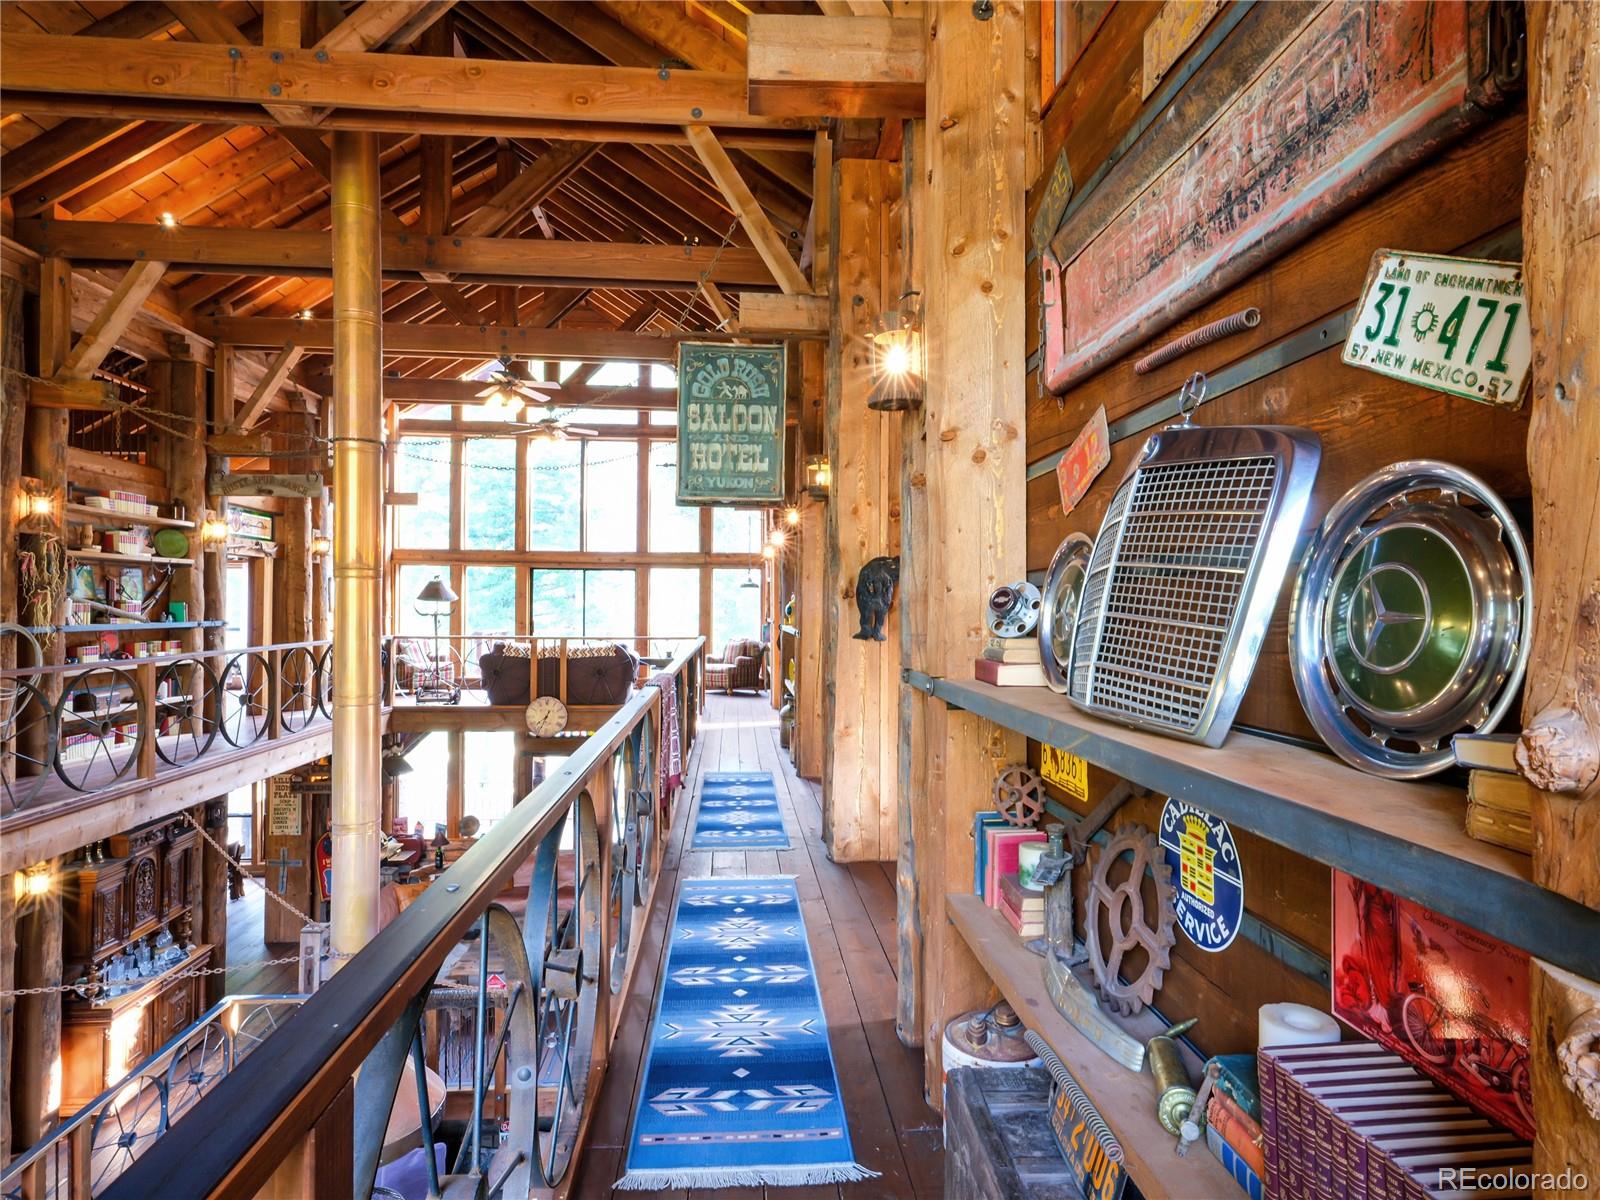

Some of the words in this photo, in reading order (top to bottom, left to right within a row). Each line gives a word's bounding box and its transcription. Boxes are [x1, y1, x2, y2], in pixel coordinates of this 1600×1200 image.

[1384, 266, 1412, 284] LAND
[1416, 269, 1431, 285] OF
[1434, 272, 1524, 297] ENCHANTMEN
[1365, 281, 1412, 348] 31
[1437, 294, 1522, 374] 471
[691, 357, 730, 398] GOLD
[731, 357, 771, 399] RUSH
[1350, 342, 1369, 360] 57
[1374, 347, 1408, 370] NEW
[1410, 357, 1479, 388] MEXICO
[687, 403, 778, 433] SALOON
[711, 434, 750, 443] AND
[690, 442, 769, 473] HOTEL
[1180, 890, 1215, 920] AUTHORIZED
